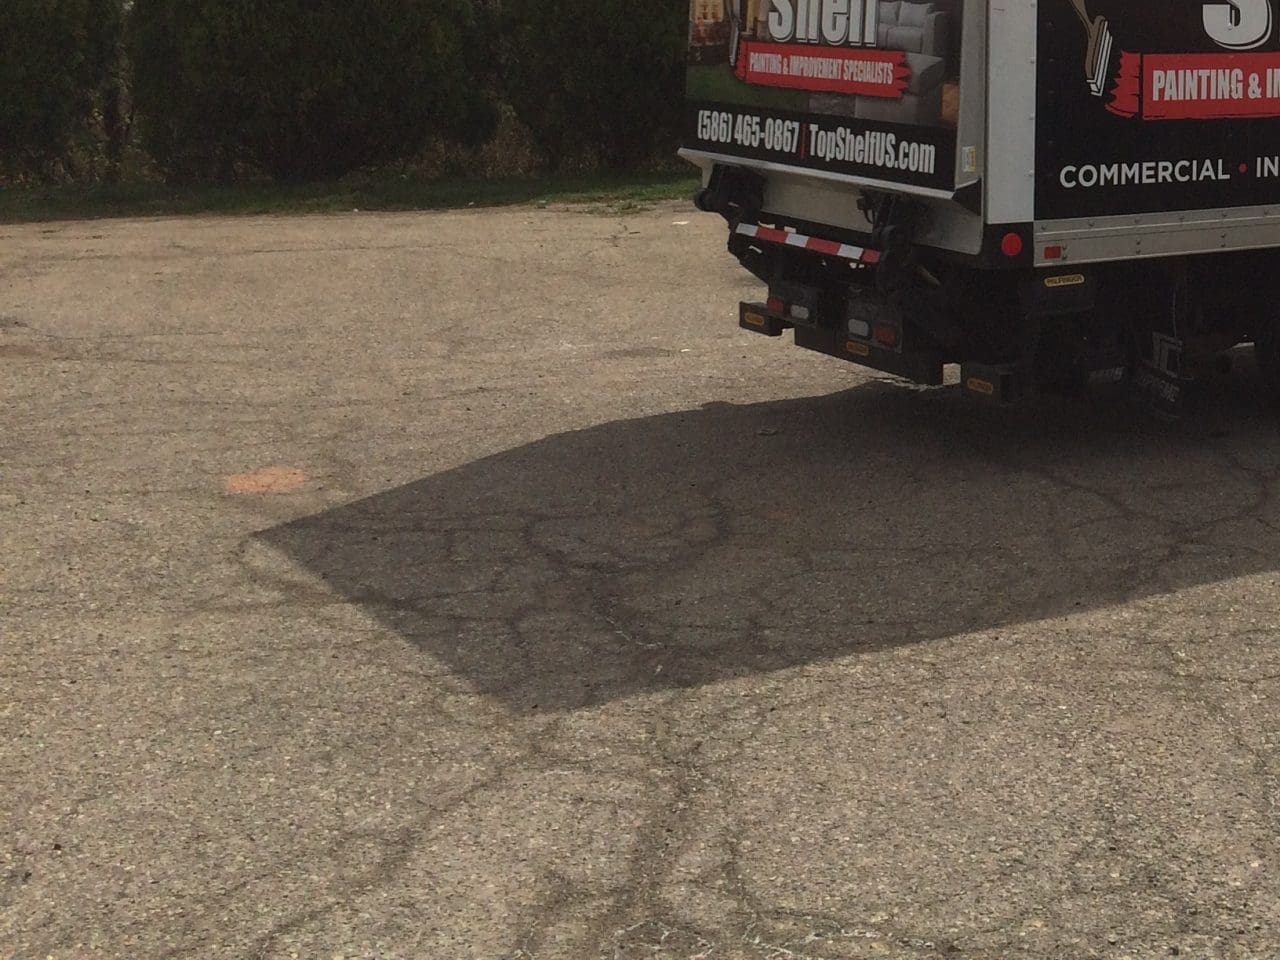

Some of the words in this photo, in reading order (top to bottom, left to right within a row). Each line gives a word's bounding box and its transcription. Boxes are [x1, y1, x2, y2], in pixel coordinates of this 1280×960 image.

[750, 52, 782, 74] PAINTING
[783, 57, 789, 75] &
[790, 55, 843, 80] IMPROVEMENT
[844, 59, 894, 85] SPECIALISTS
[1152, 68, 1243, 101] PAINTING
[1248, 72, 1262, 100] &
[698, 109, 732, 143] (586)
[734, 114, 800, 154] 465-0867
[809, 123, 936, 174] TopShelfUS.com
[1059, 157, 1231, 189] COMMERCIAL
